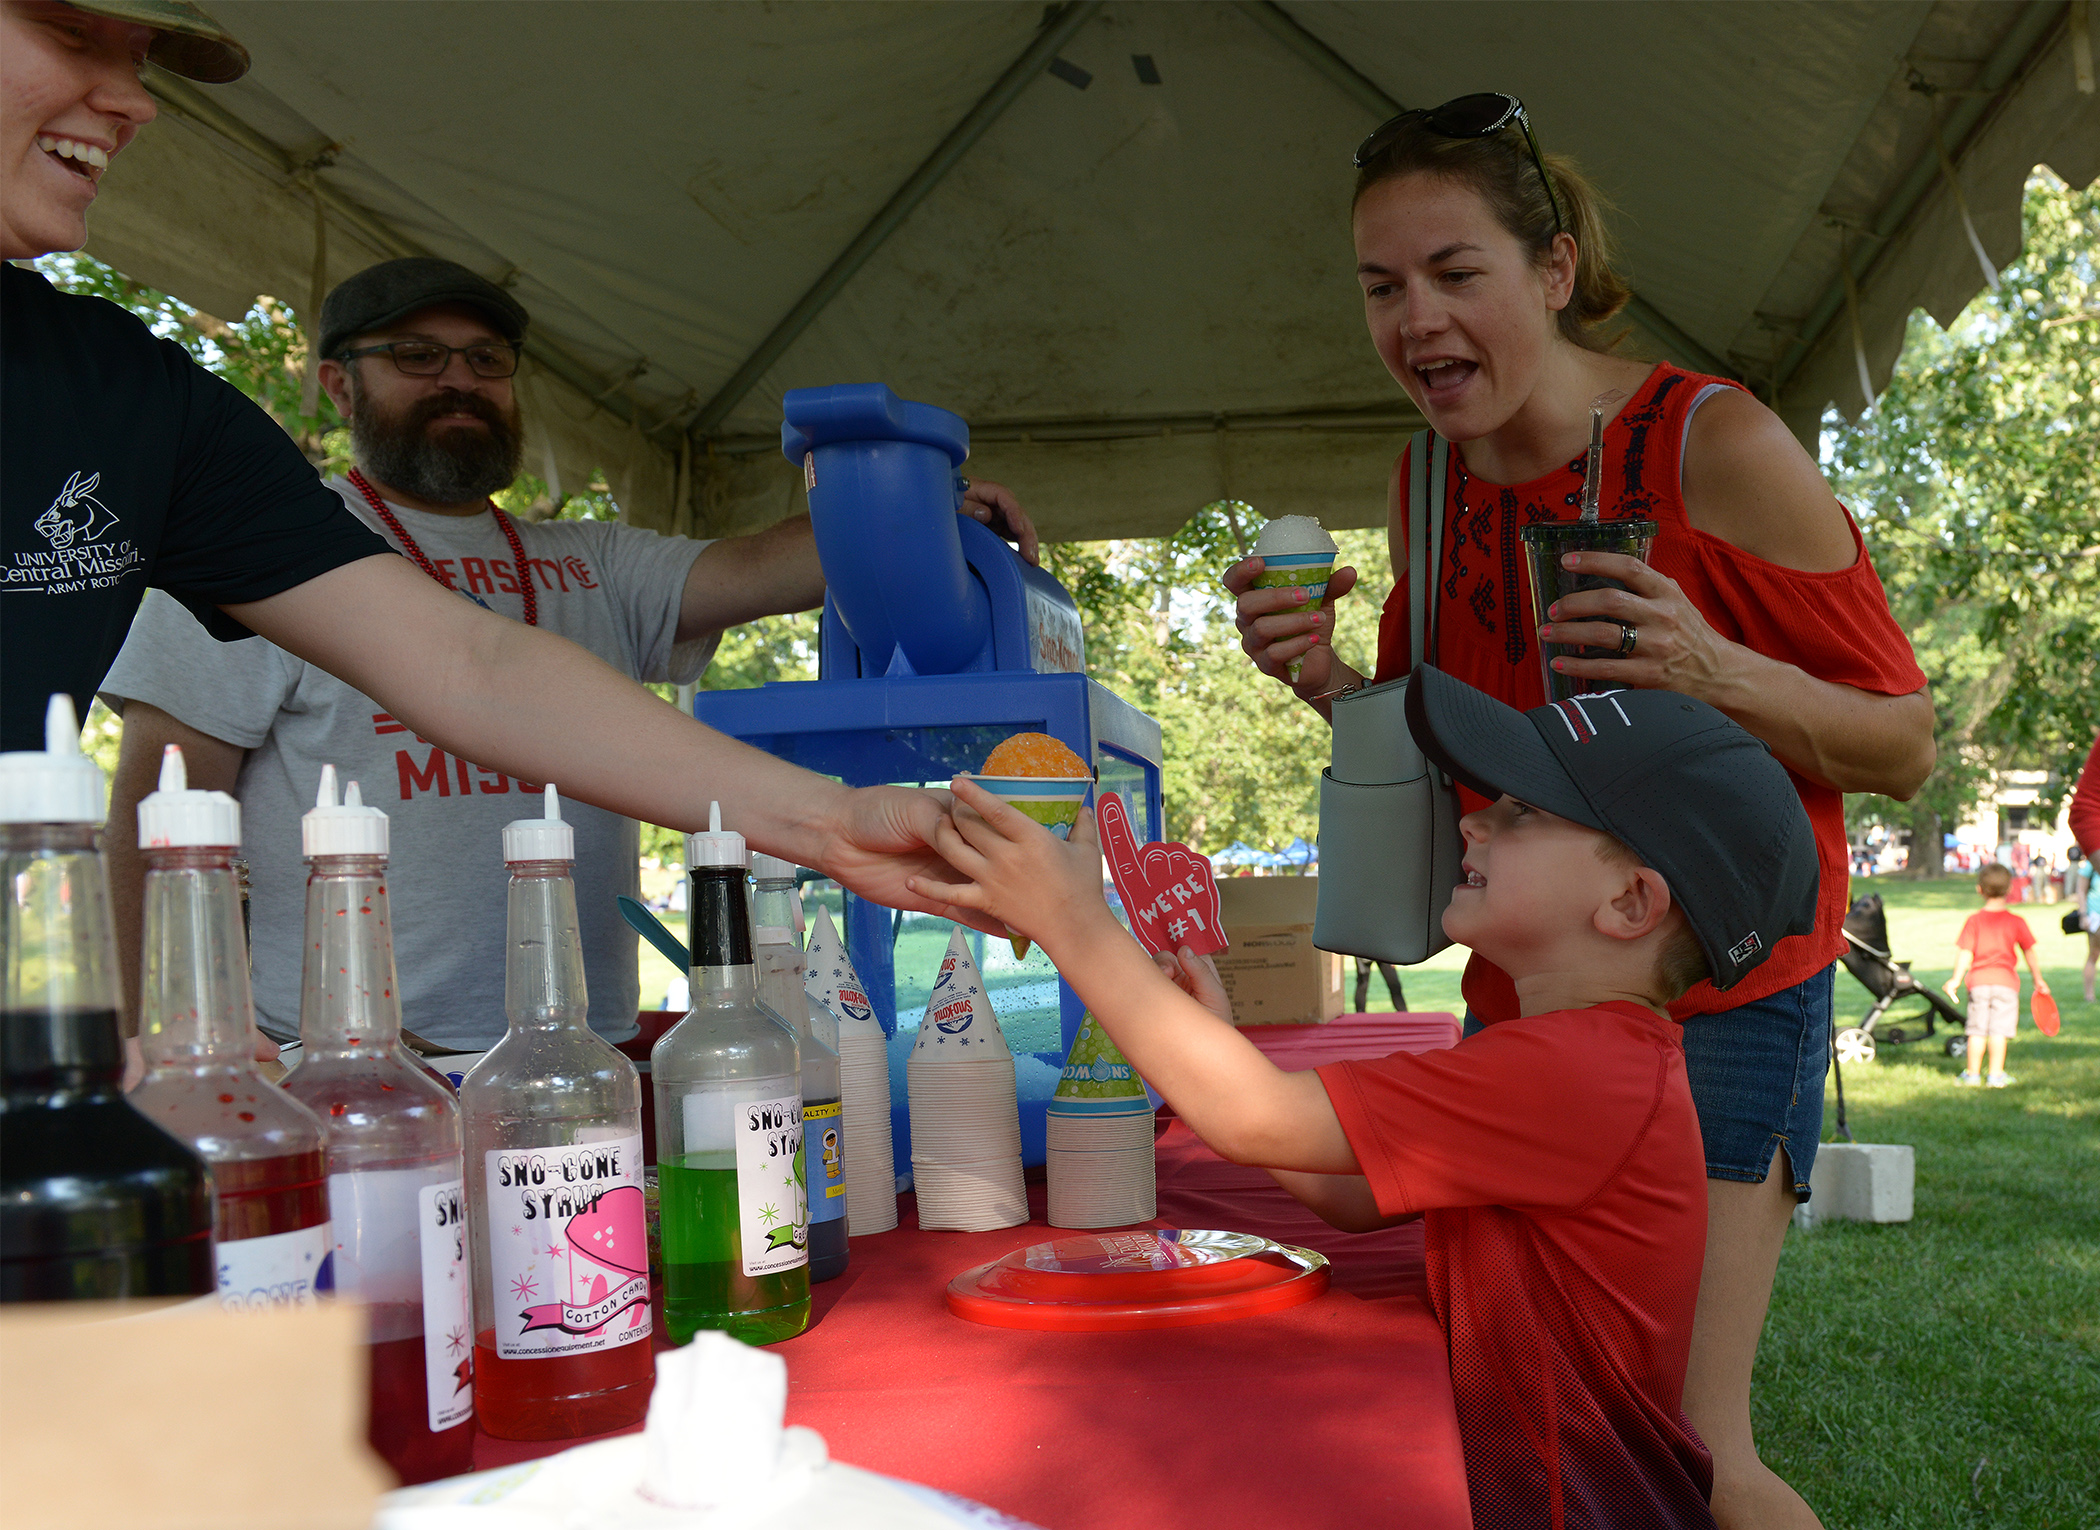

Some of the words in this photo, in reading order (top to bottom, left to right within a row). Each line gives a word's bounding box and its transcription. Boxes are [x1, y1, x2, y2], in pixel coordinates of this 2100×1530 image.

[14, 542, 116, 566] UNIVERSITY
[0, 562, 73, 583] Central
[47, 580, 87, 595] ARMY
[91, 575, 121, 589] ROTC
[1139, 873, 1205, 926] WE'RE
[1167, 908, 1206, 942] #1
[803, 1108, 829, 1118] ALITY
[497, 1146, 622, 1187] SNO-CONE
[521, 1183, 604, 1220] SYRUP
[566, 1299, 617, 1323] COTTON
[622, 1281, 647, 1300] CANDY
